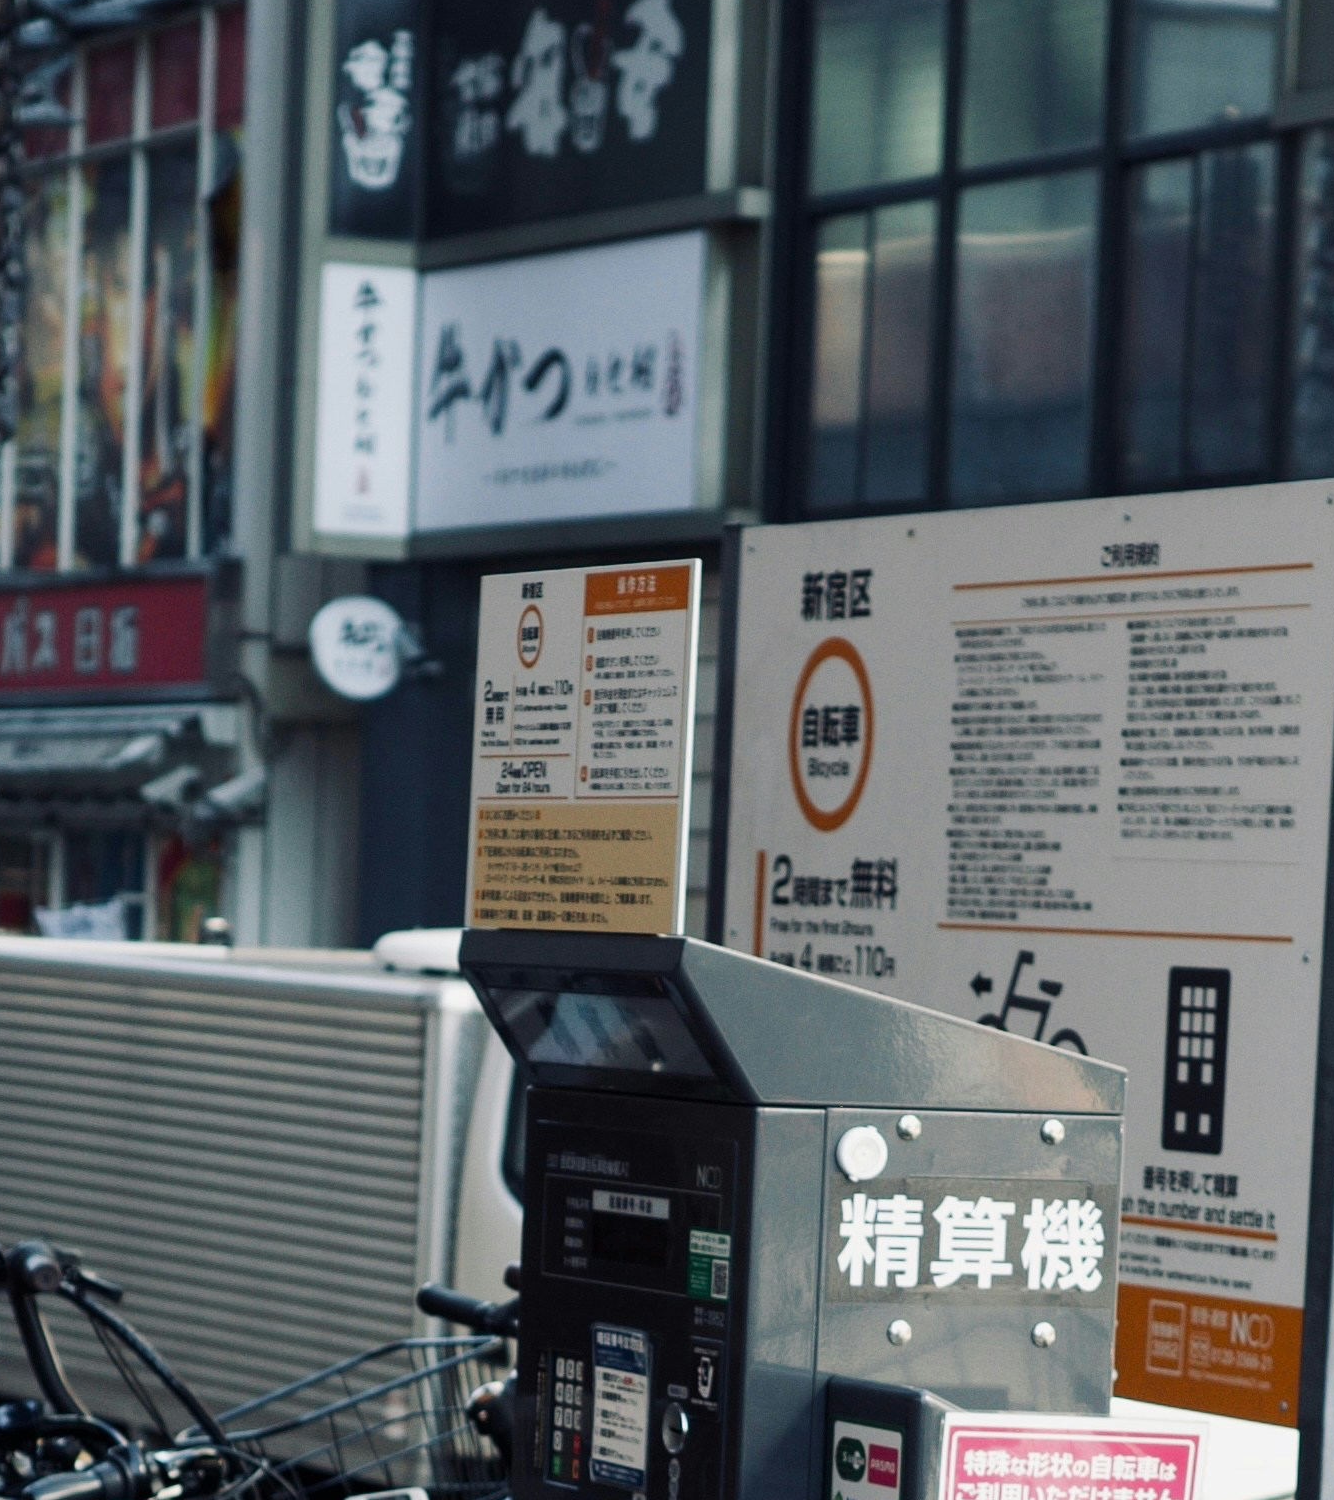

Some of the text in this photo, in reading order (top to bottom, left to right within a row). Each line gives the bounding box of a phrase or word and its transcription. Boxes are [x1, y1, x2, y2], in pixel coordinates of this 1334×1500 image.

[800, 568, 873, 622] 新宿区
[801, 703, 861, 750] 自転車
[807, 756, 851, 779] Bicycle
[1143, 1165, 1239, 1198] 番号を押して精算
[1158, 1198, 1202, 1221] number
[1203, 1204, 1225, 1224] and
[836, 1193, 1105, 1292] 精算機
[963, 1448, 1177, 1482] 特殊な形状の自転車は
